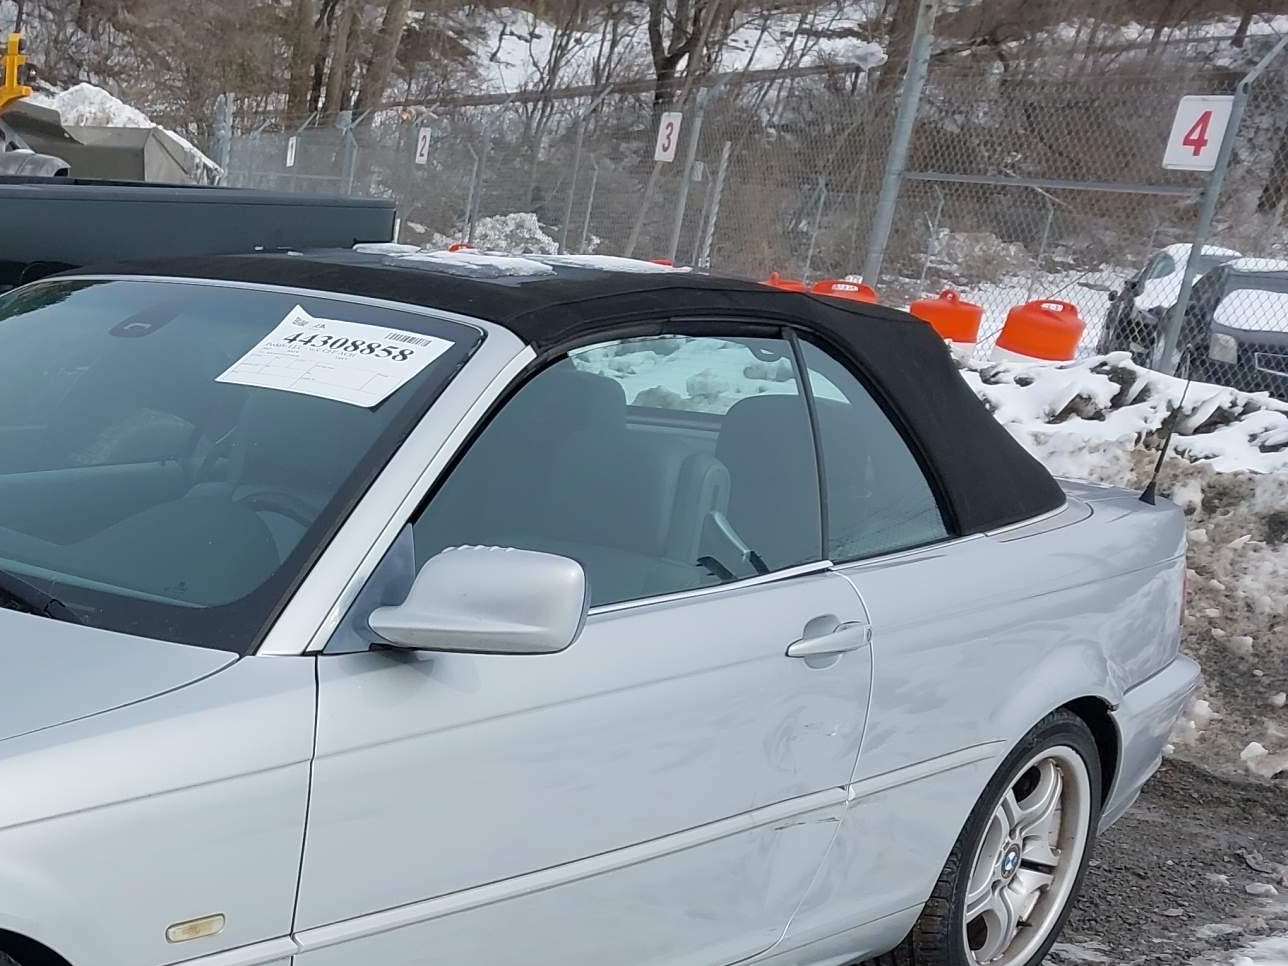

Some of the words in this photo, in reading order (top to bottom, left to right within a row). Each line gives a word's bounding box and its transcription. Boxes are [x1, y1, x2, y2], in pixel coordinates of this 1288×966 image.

[418, 135, 427, 158] 2
[662, 121, 674, 153] 3
[1182, 111, 1213, 157] 4
[283, 331, 414, 362] 44308858
